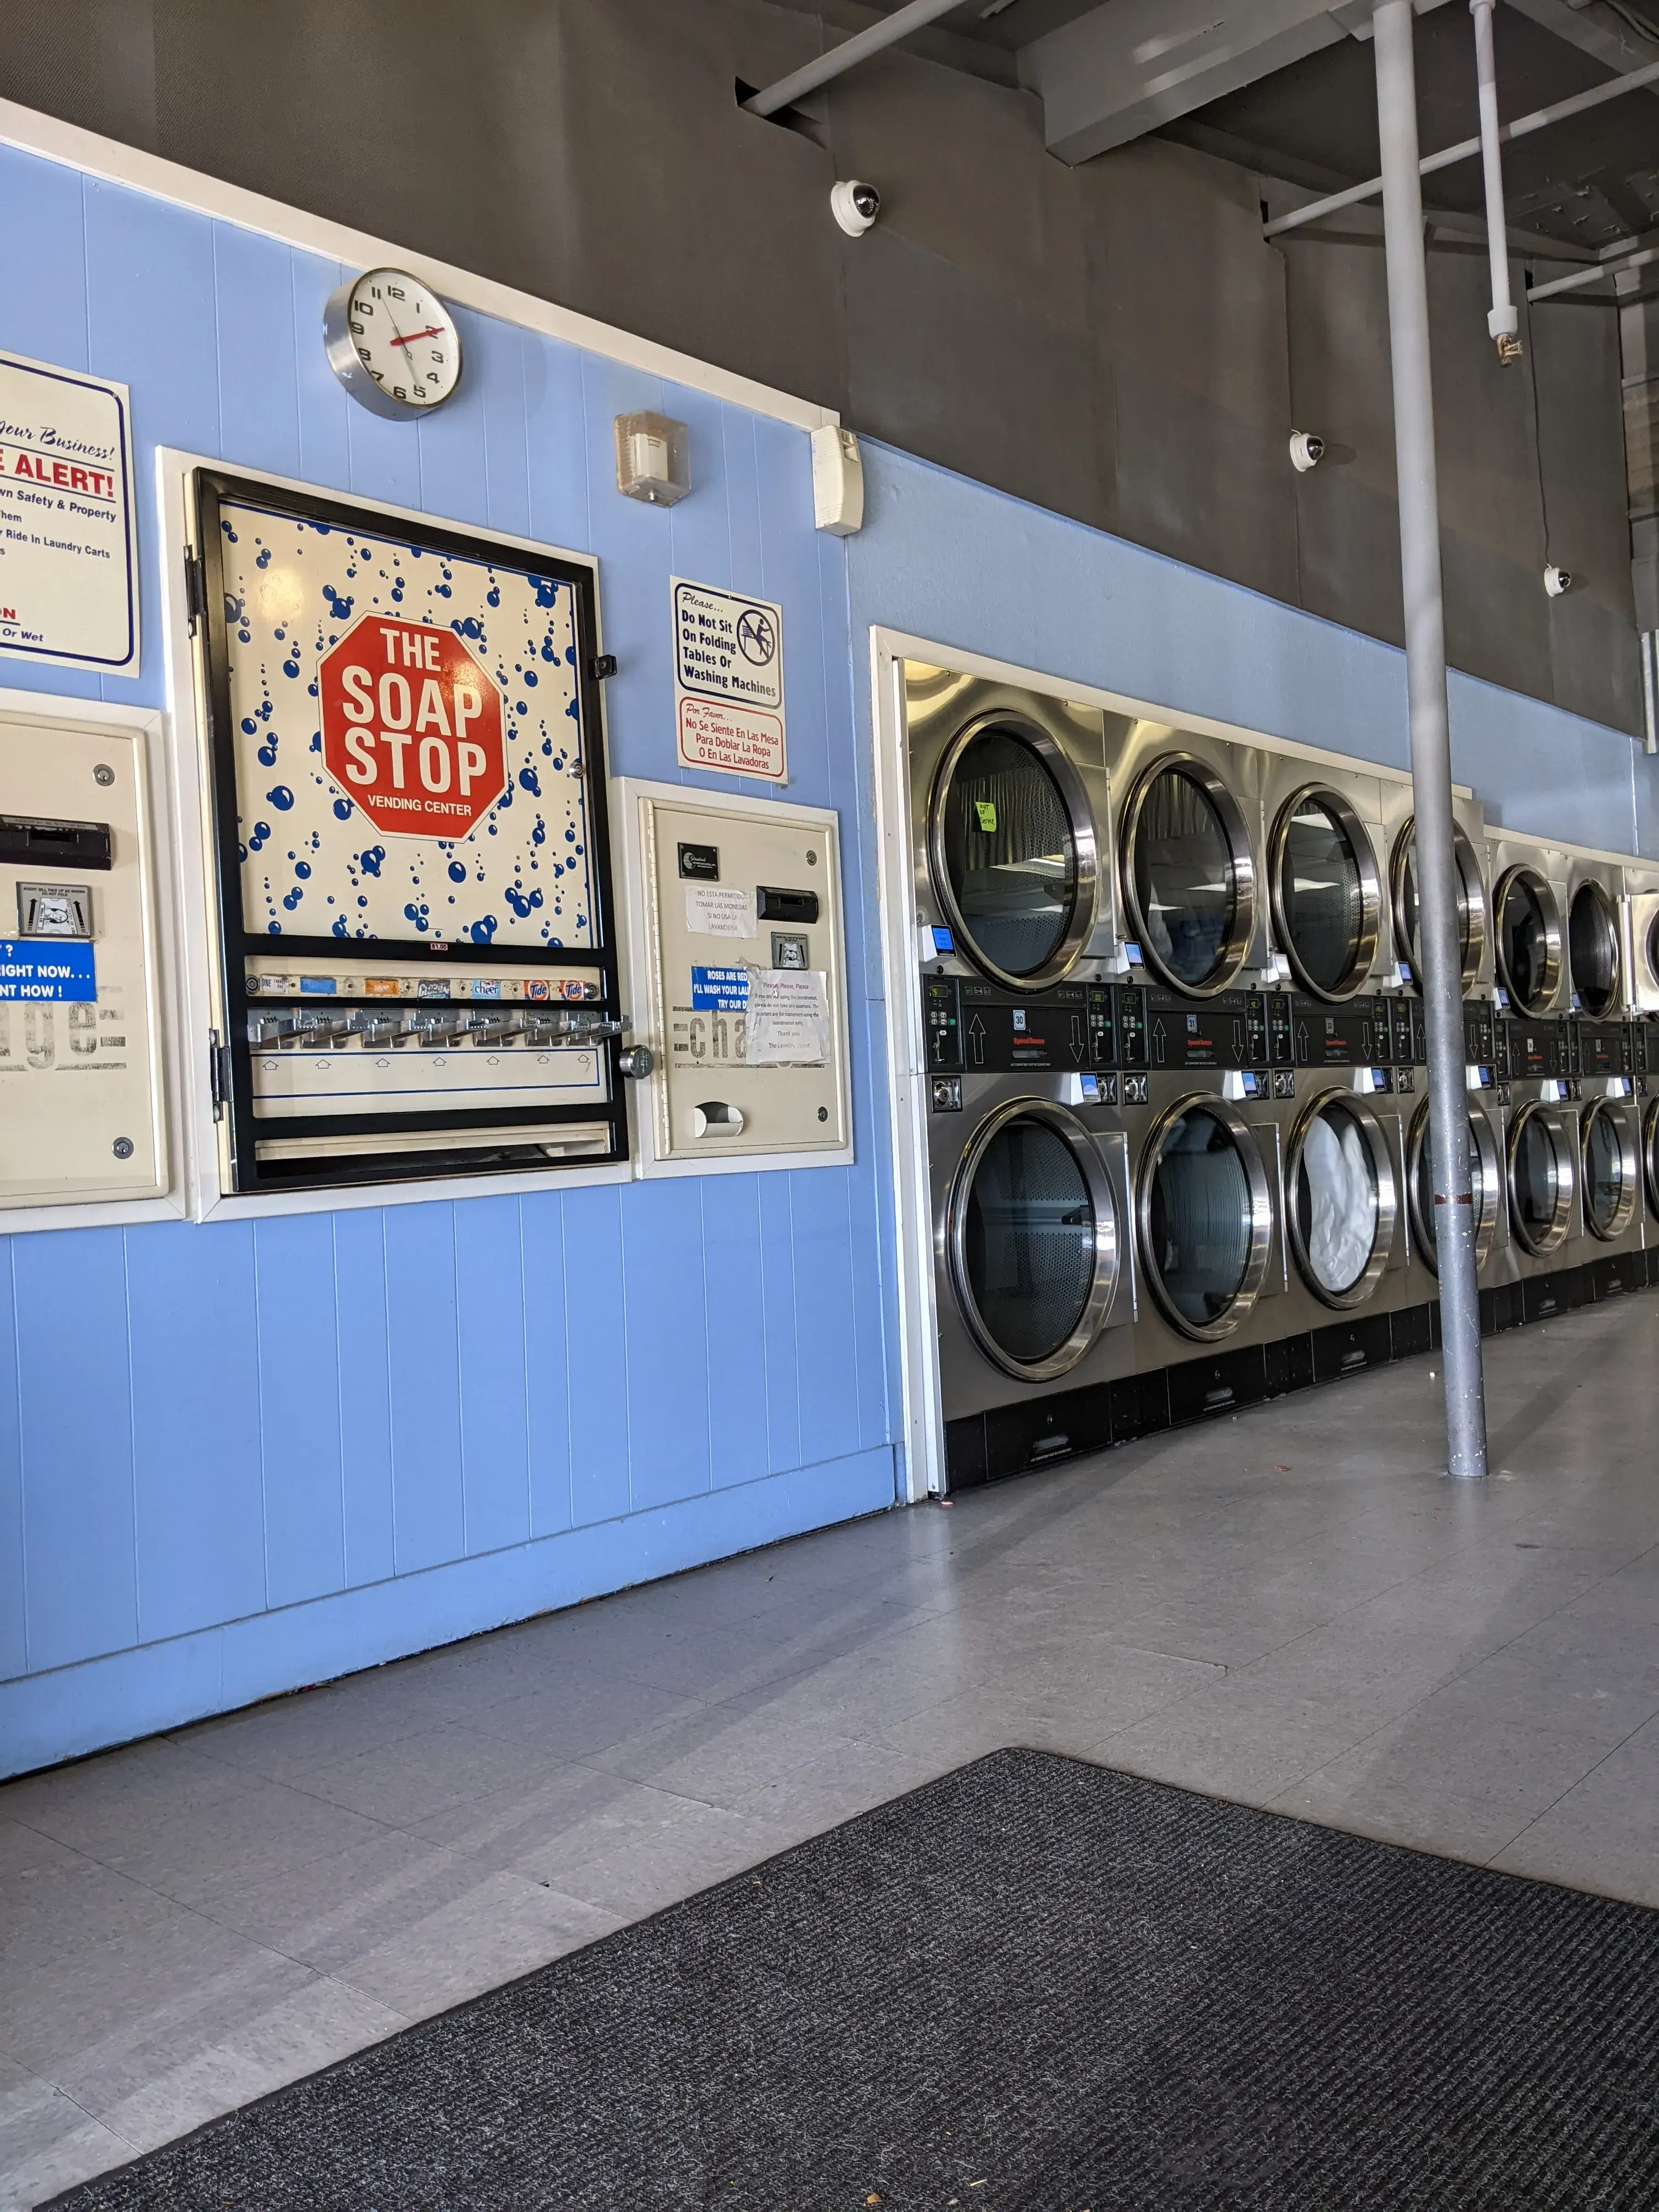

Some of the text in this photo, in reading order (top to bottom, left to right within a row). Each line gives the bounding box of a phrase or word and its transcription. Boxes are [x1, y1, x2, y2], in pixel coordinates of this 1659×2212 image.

[371, 286, 382, 301] 11
[387, 285, 406, 302] 12
[354, 300, 374, 316] 10
[416, 302, 420, 314] 1
[351, 321, 364, 335] 9
[358, 347, 371, 362] 8
[431, 350, 444, 364] 3
[371, 370, 385, 382] 7
[426, 372, 440, 384] 4
[393, 386, 407, 399] 6
[414, 384, 426, 398] 5
[40, 426, 115, 460] Business!
[15, 454, 114, 498] ALERT!
[17, 490, 53, 509] Safety
[57, 500, 65, 510] &
[70, 502, 116, 522] Property
[7, 528, 110, 558] Ride In Laundry Carts
[681, 609, 733, 634] Do Not Sit
[3, 628, 43, 642] Or Wet
[682, 628, 736, 655] On Folding
[380, 627, 441, 672] THE
[683, 646, 732, 669] Tables Or
[684, 664, 776, 697] Washing Machines
[342, 665, 483, 738] SOAP
[686, 703, 701, 715] Por
[686, 718, 778, 746] No Se Siente En Las Mesa
[696, 732, 771, 758] Para Doblar La Ropa
[345, 727, 487, 796] STOP
[699, 747, 769, 770] O En Las Lavadoras
[367, 794, 472, 816] VENDING CENTER
[708, 970, 748, 981] ROSES ARE RED
[21, 985, 54, 997] HOW
[475, 981, 499, 995] cheer
[529, 983, 547, 999] Tide
[565, 983, 582, 998] Tide
[693, 984, 703, 994] I'LL
[704, 984, 721, 995] WASH
[721, 985, 737, 995] YOUR
[718, 1000, 728, 1008] TRY
[729, 1000, 741, 1009] OUR
[1015, 1016, 1023, 1024] 30
